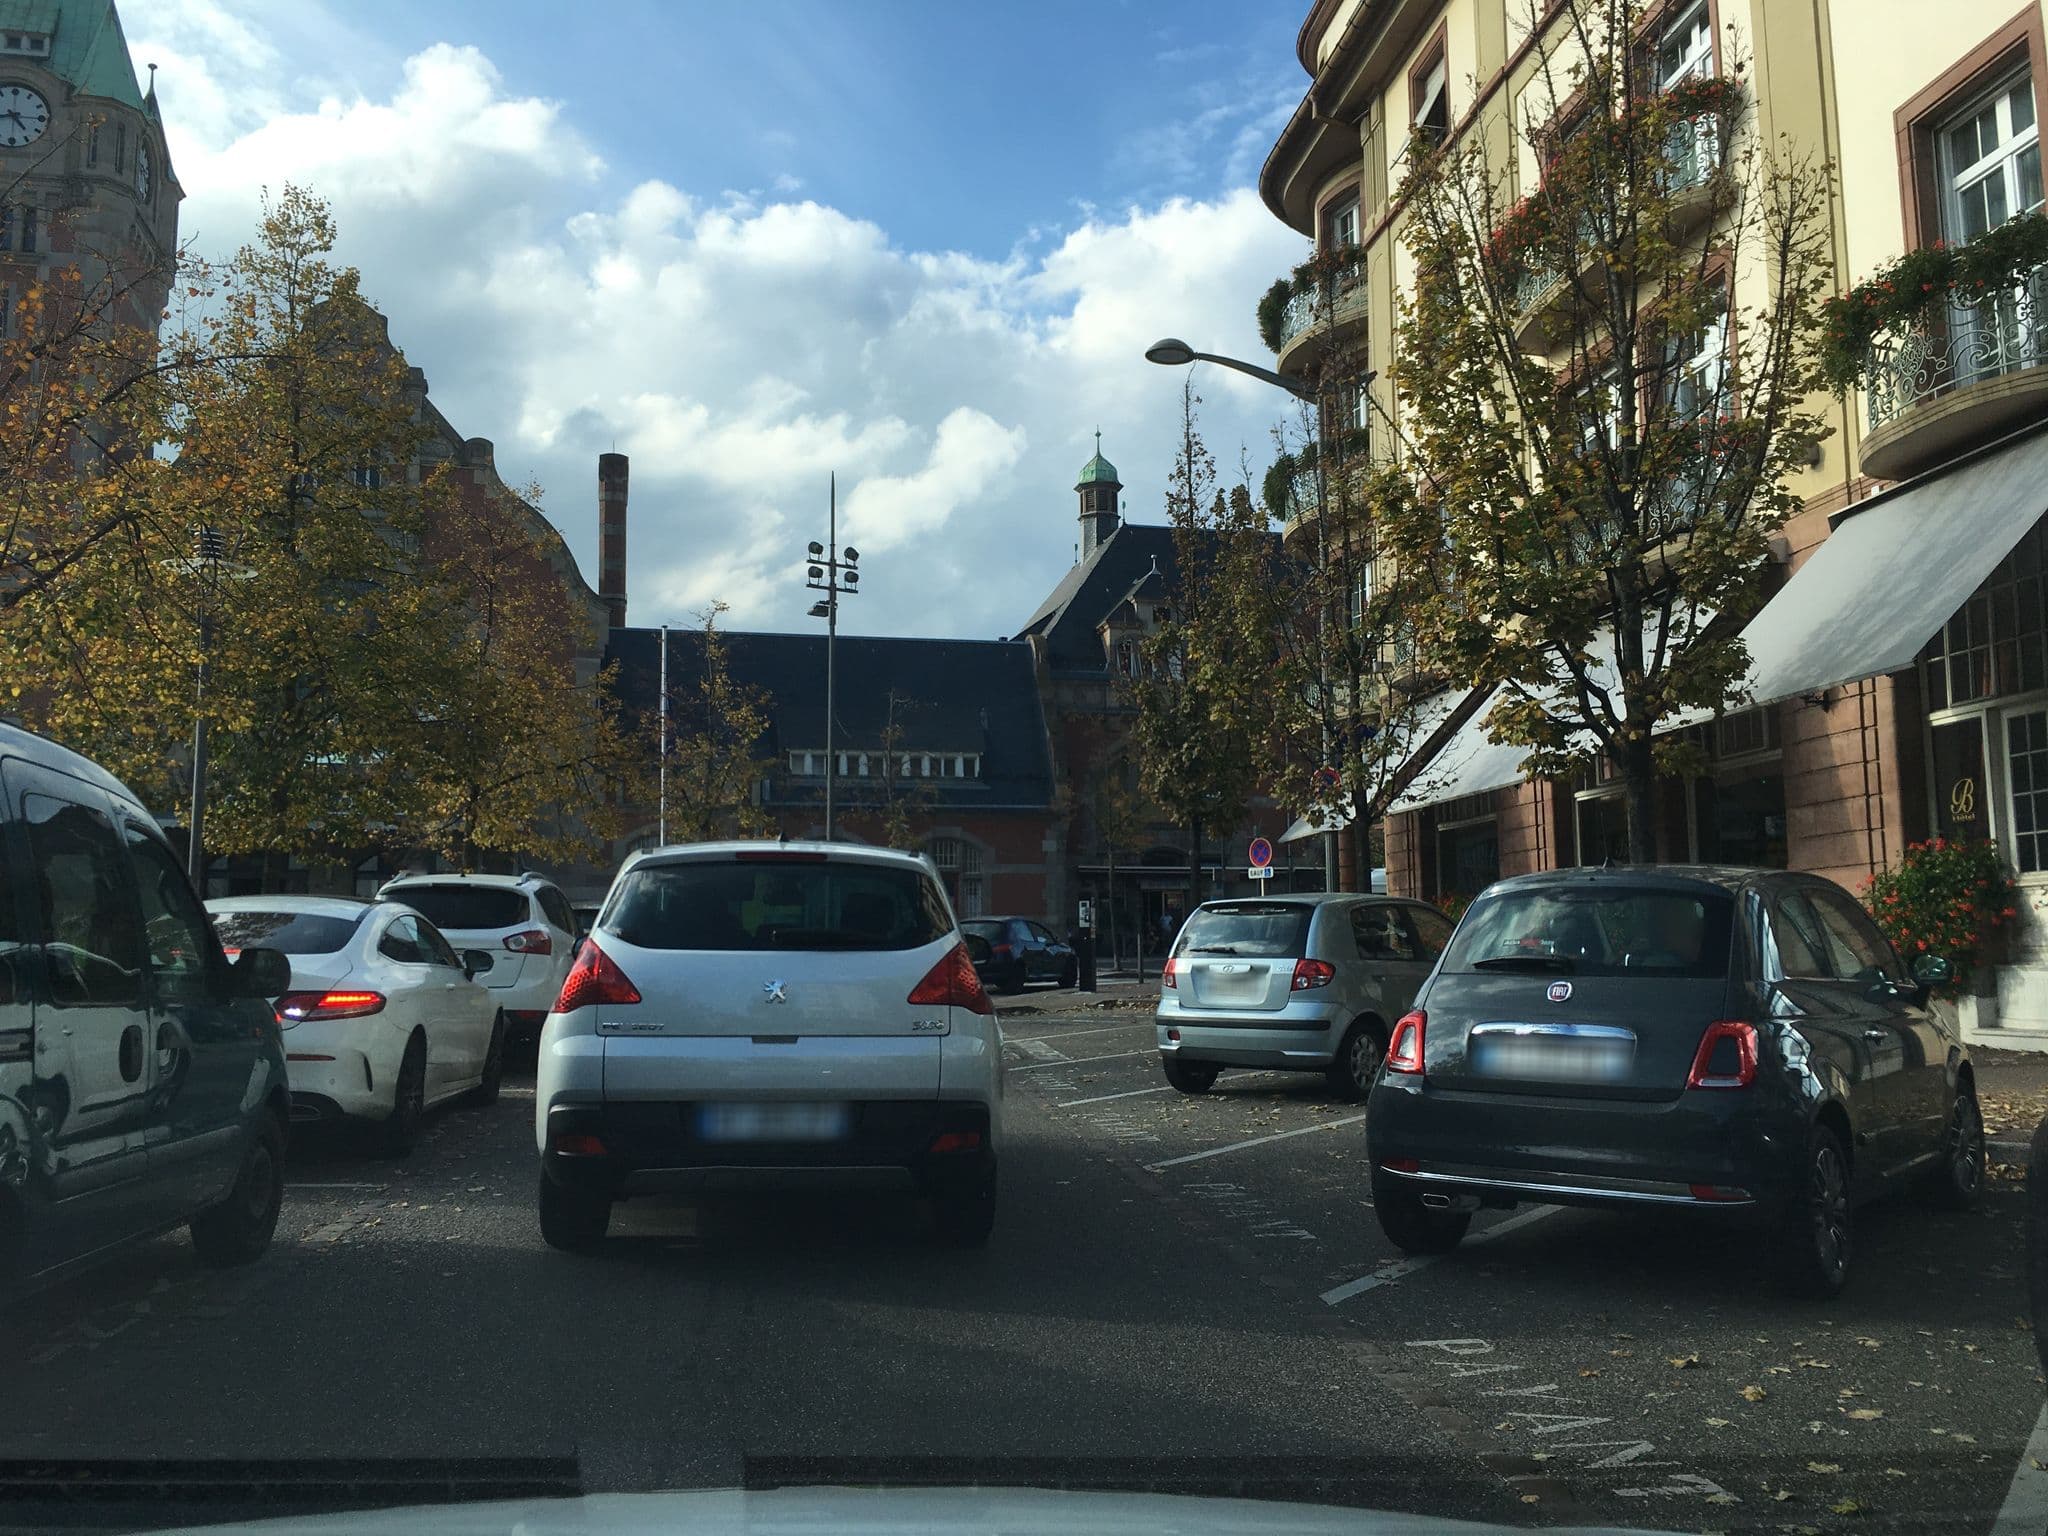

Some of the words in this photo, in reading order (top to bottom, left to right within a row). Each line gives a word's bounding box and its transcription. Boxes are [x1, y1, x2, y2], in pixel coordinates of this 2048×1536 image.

[1950, 778, 1974, 814] B
[1552, 986, 1568, 997] FIAT
[602, 1022, 665, 1031] PEGEOT
[1402, 1338, 1744, 1503] PAYANT
